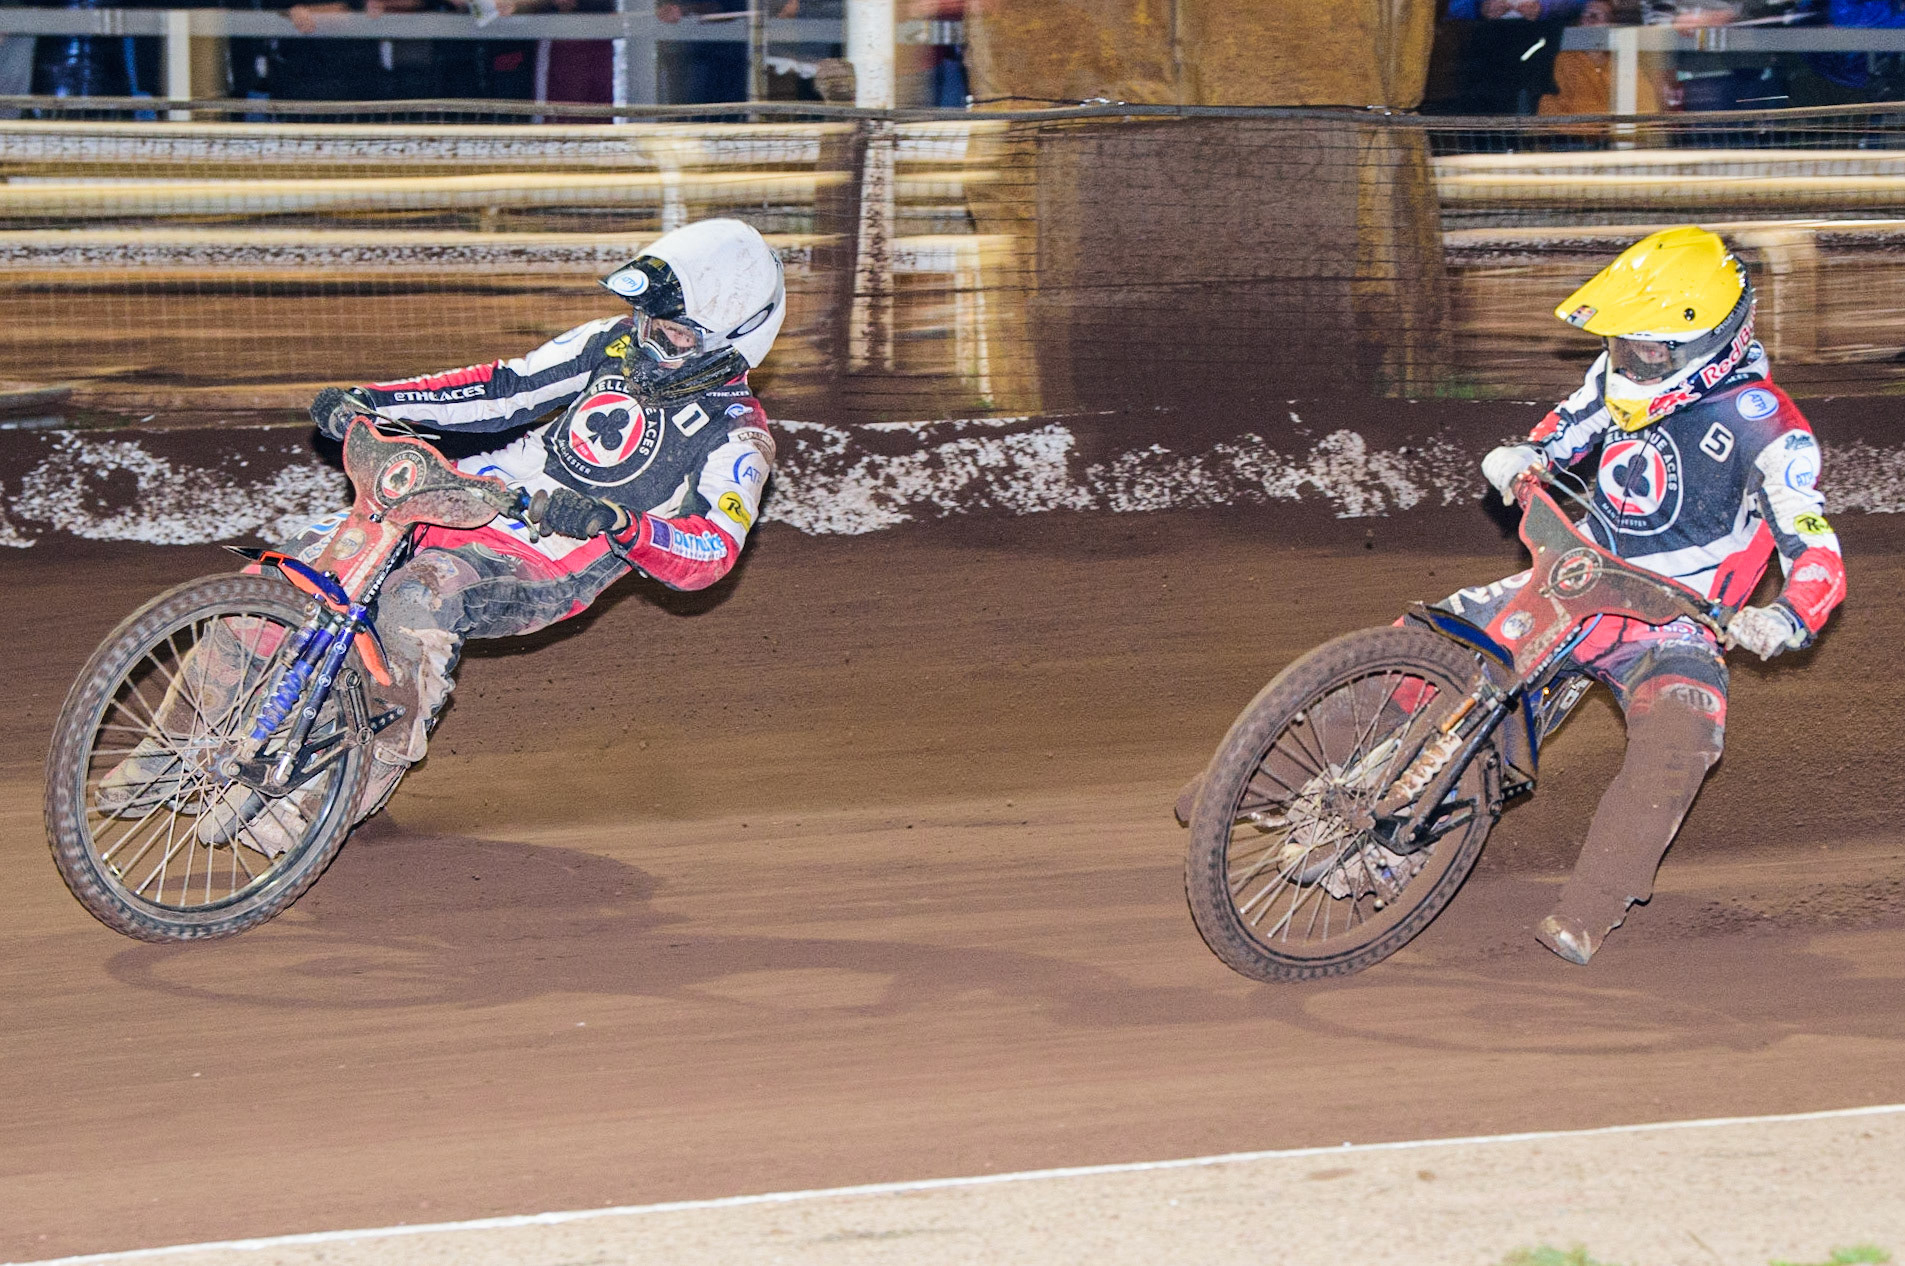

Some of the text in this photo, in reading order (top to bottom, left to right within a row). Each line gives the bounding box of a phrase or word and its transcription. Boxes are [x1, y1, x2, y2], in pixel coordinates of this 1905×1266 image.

[1701, 338, 1743, 388] Red
[639, 420, 658, 457] ACES
[681, 410, 702, 430] 1
[1706, 427, 1730, 457] 5
[1603, 431, 1638, 448] ELLE
[1663, 454, 1679, 492] ACES
